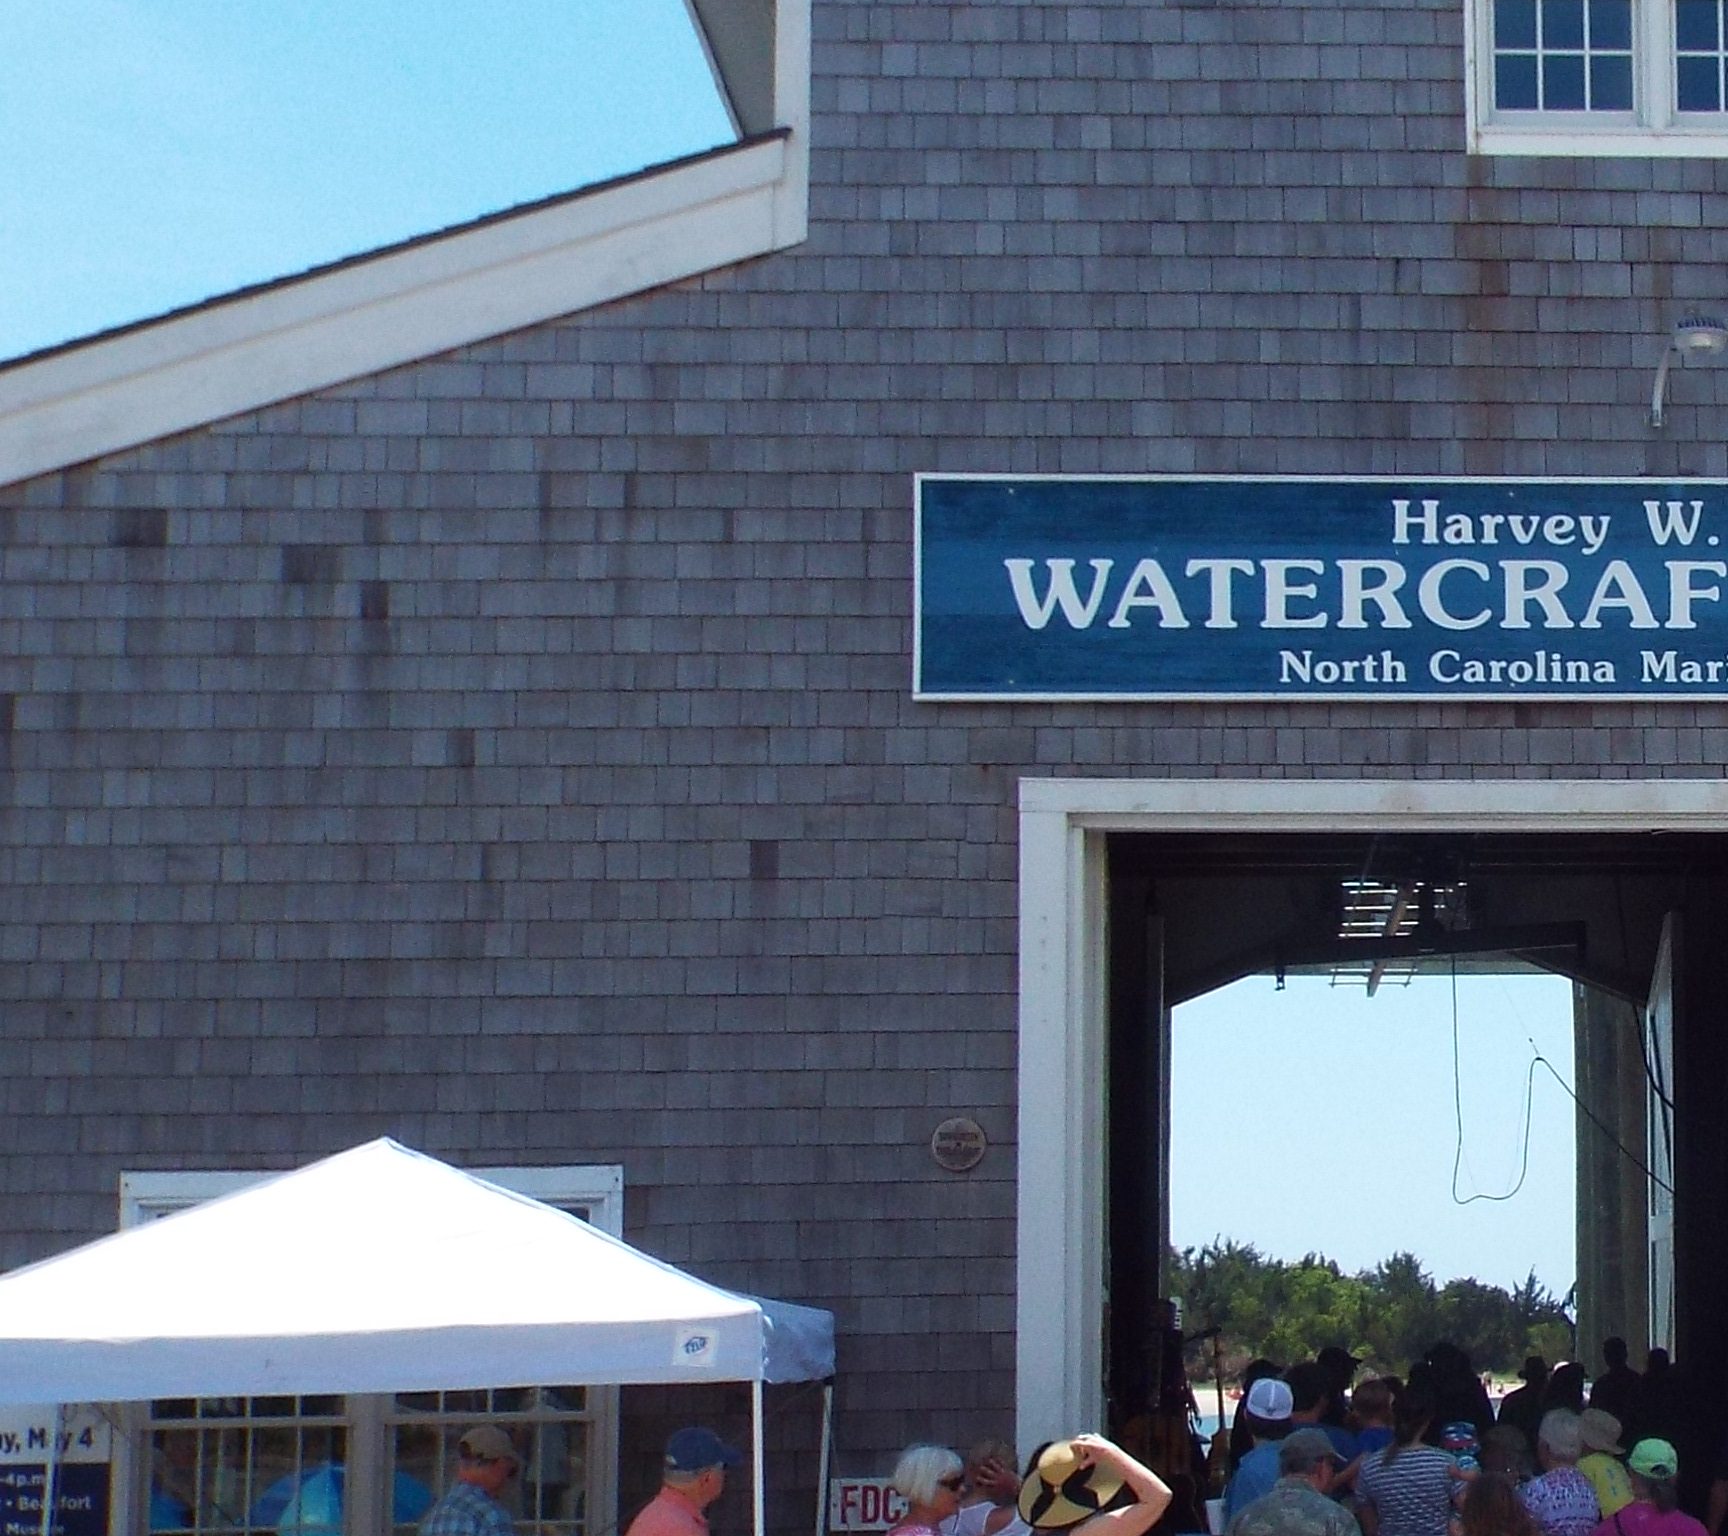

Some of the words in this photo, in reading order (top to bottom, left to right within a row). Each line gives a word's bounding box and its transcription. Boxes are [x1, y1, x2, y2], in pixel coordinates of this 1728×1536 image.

[1393, 499, 1610, 555] Harvey
[1643, 500, 1719, 546] W.
[1280, 651, 1407, 683] North
[1429, 651, 1615, 683] Carolina
[28, 1427, 73, 1452] My
[79, 1427, 93, 1448] 4
[19, 1496, 91, 1511] Befort
[841, 1485, 902, 1524] FDC
